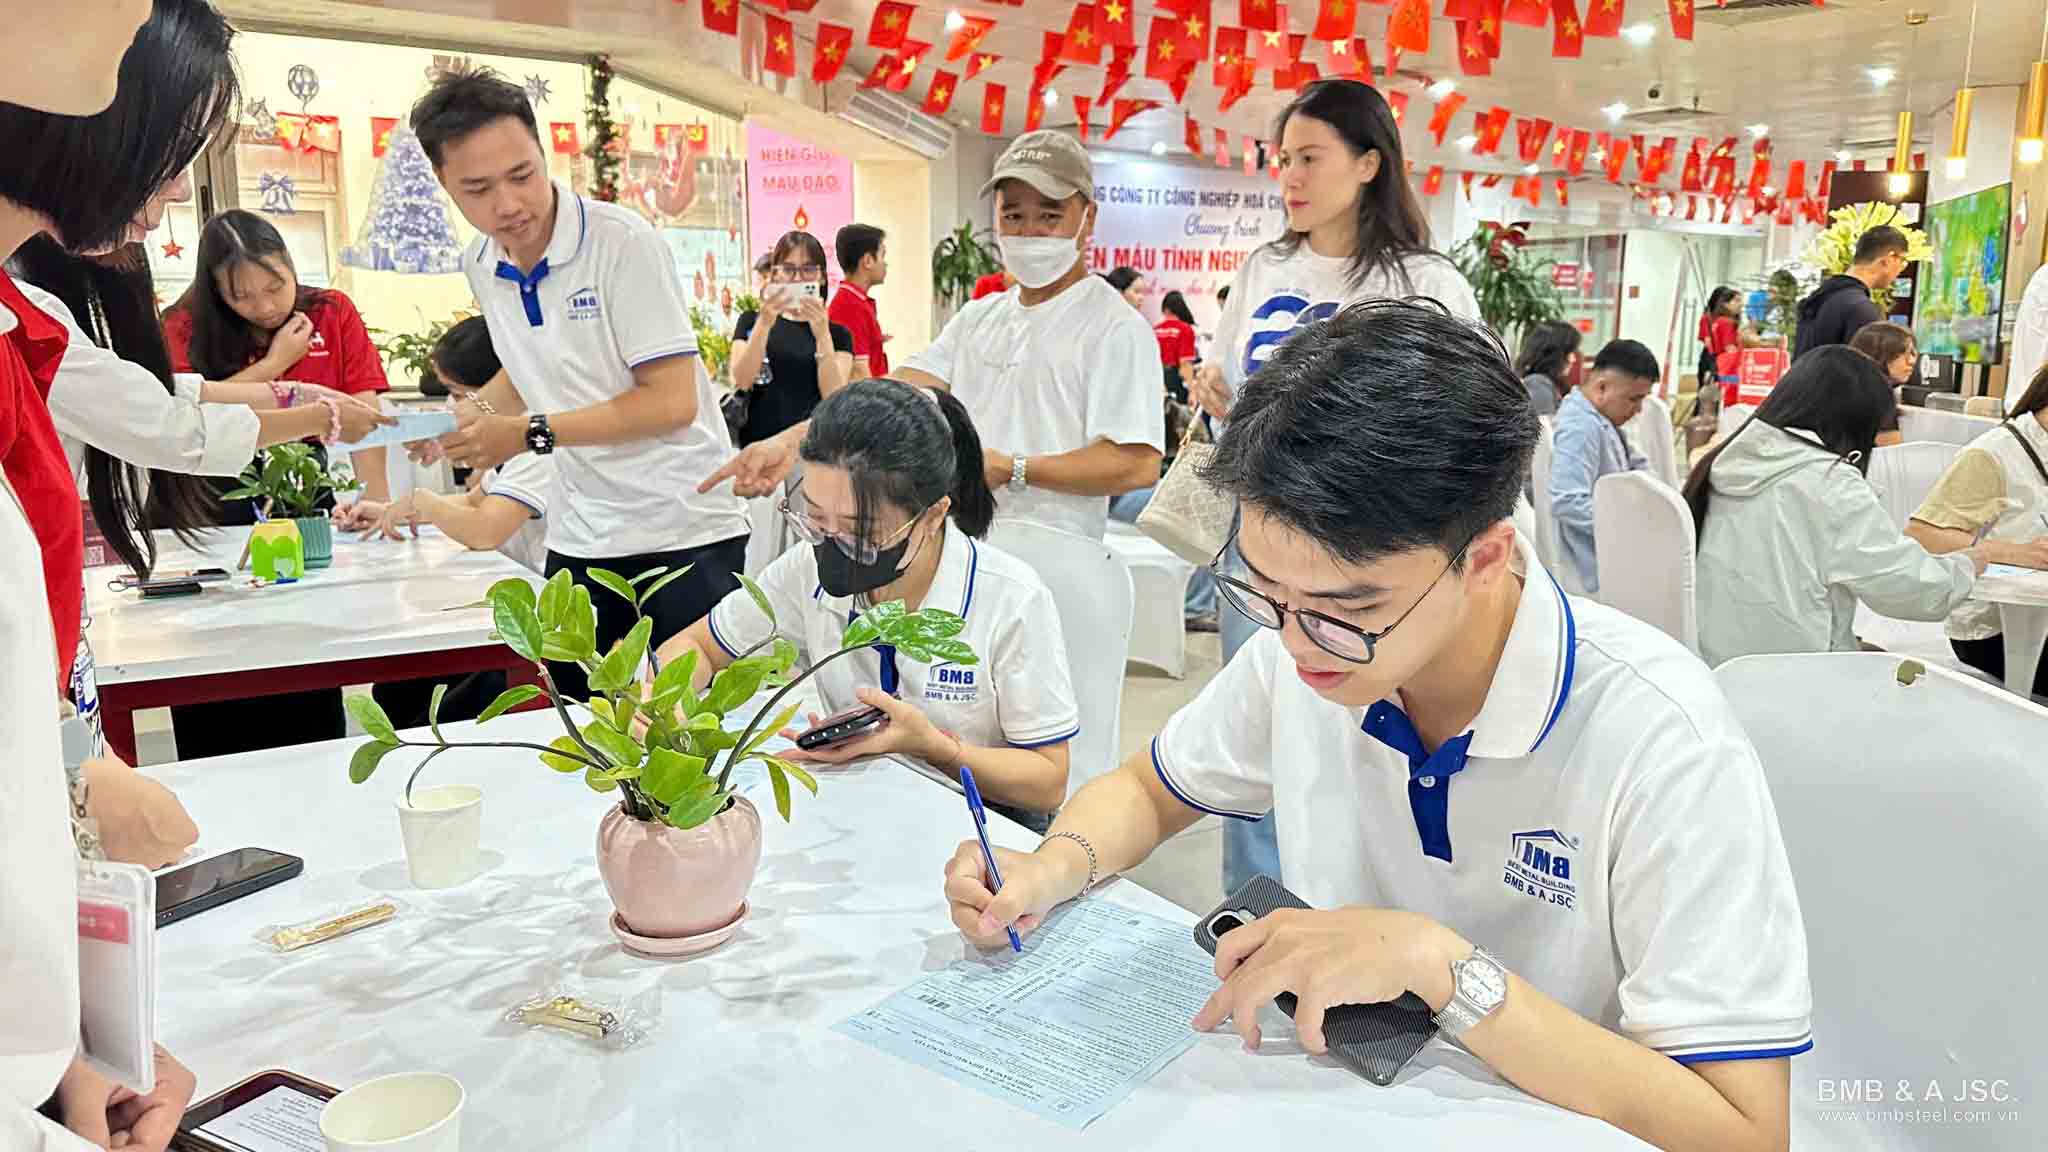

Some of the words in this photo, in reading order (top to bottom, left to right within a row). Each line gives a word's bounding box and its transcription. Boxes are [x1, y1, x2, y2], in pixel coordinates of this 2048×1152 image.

[1147, 188, 1161, 205] TY
[1114, 240, 1156, 271] MÁU
[1162, 243, 1203, 272] TÌNH
[939, 669, 974, 684] BMB
[1504, 872, 1524, 891] BMB
[1527, 885, 1536, 896] &
[1538, 889, 1546, 901] A
